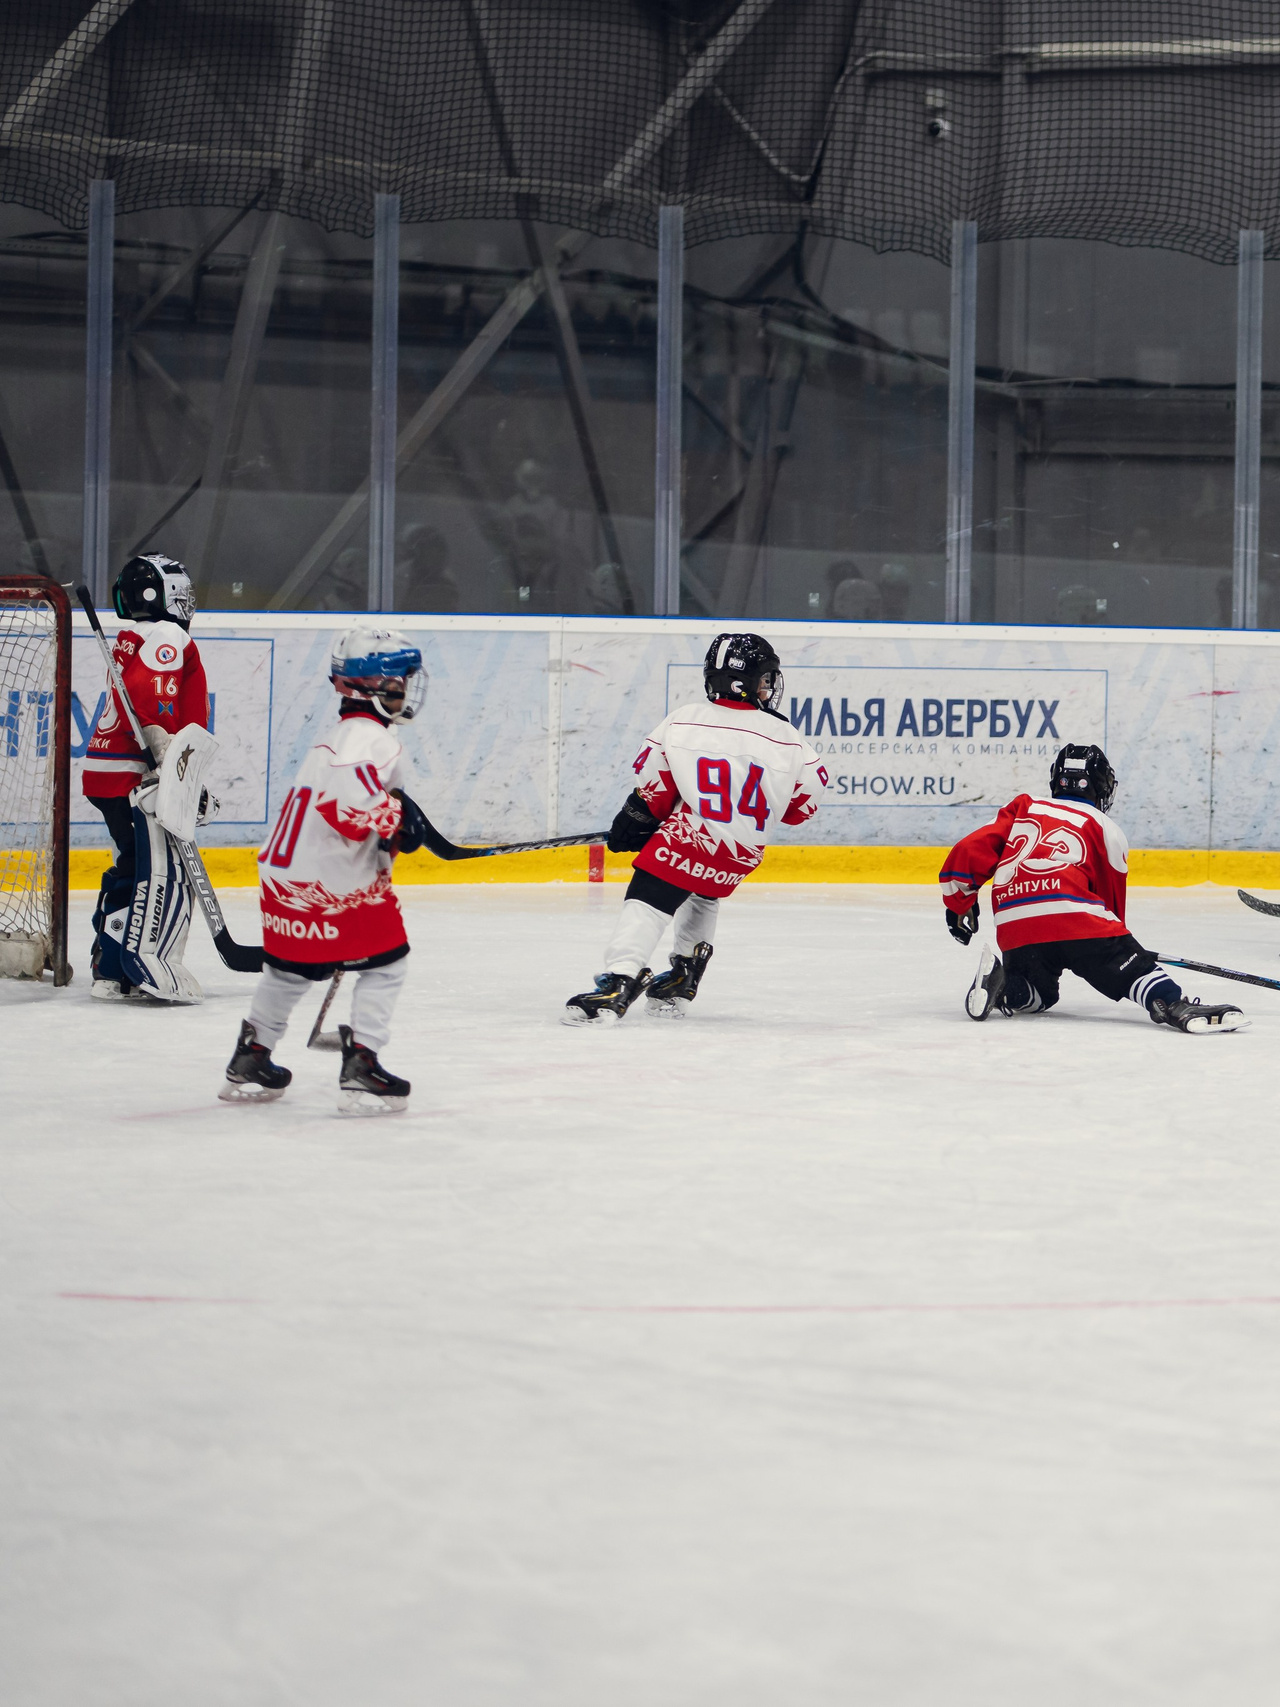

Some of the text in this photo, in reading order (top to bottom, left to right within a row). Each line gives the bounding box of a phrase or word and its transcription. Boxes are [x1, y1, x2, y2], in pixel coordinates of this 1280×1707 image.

[151, 675, 178, 696] 16
[790, 697, 1060, 738] ИЛЬЯ АВЕРБУХ
[808, 742, 1060, 755] ОДЮСЕРСКАЯ КОМПАНИЯ
[697, 757, 770, 832] 94
[150, 884, 165, 943] VAUGHN
[182, 840, 223, 932] BAUER
[126, 880, 148, 953] VAUGHN
